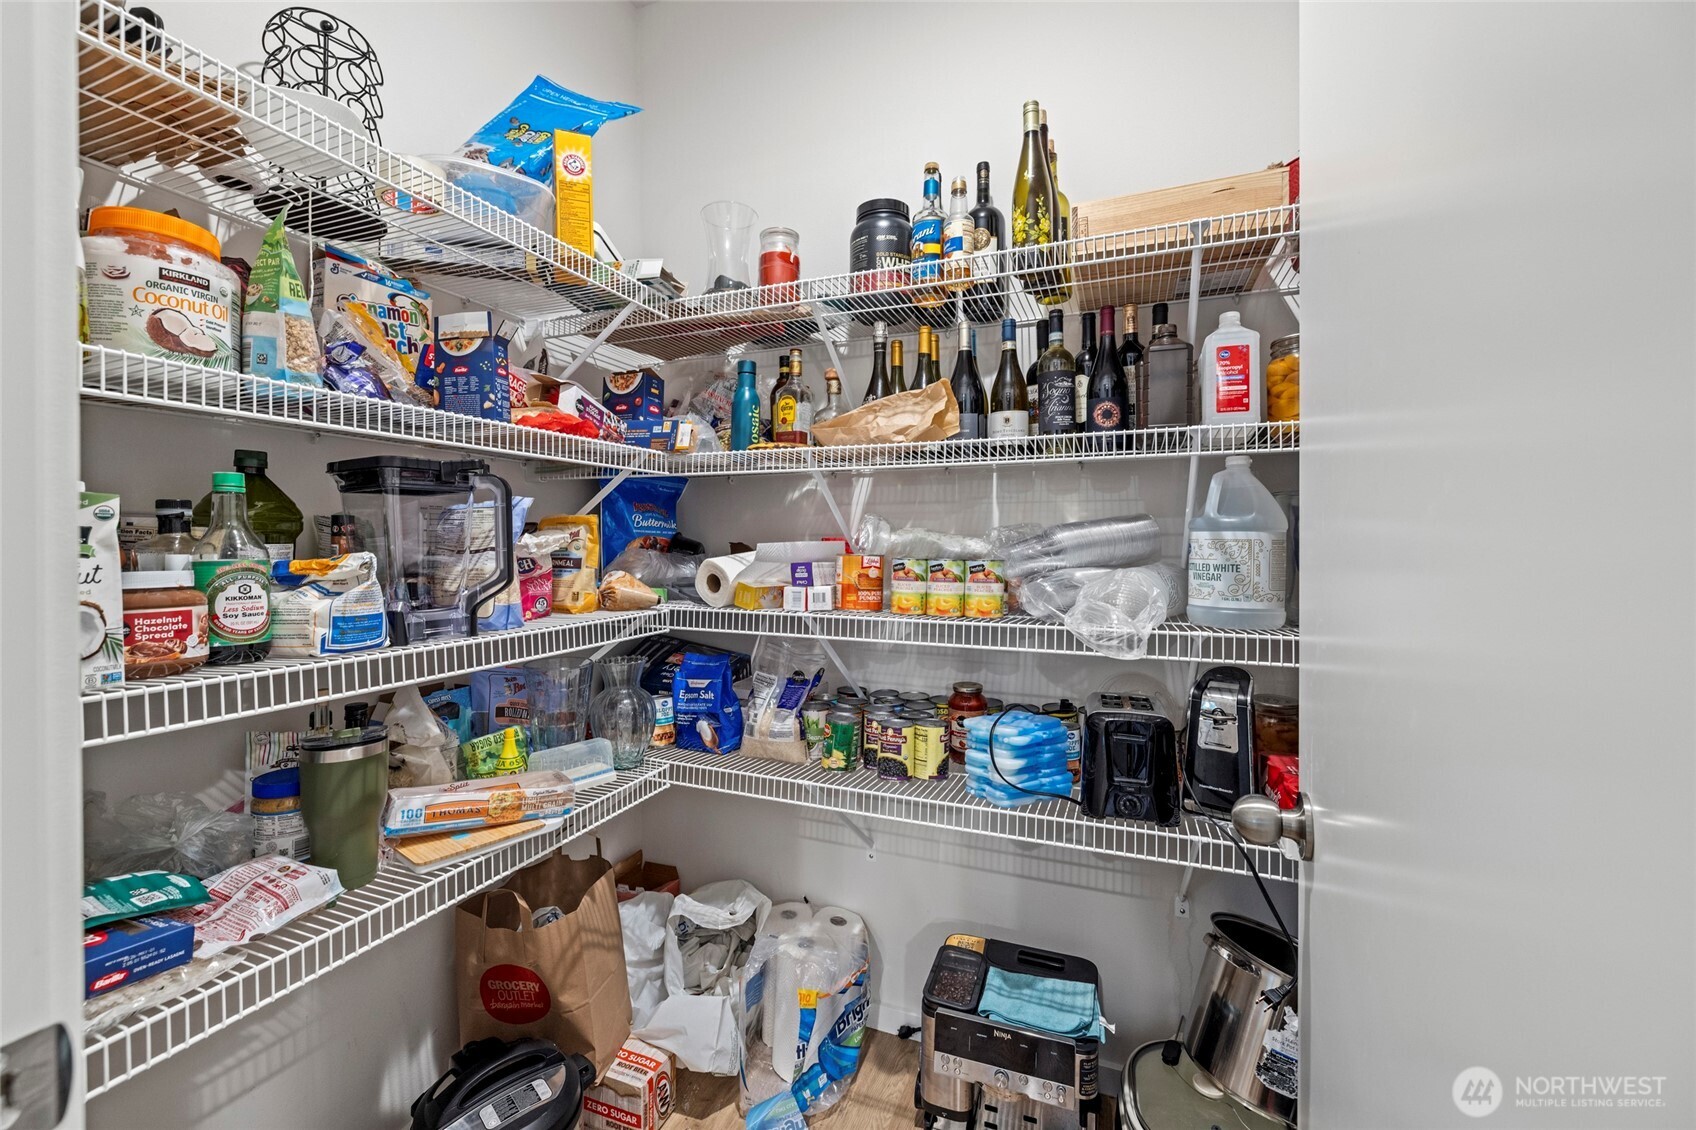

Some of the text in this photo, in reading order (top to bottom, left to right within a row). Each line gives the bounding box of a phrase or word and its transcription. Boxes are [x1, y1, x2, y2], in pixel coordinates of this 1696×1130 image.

[912, 223, 935, 243] rani
[881, 257, 911, 273] WHE
[162, 269, 208, 286] KIRKLAND
[145, 280, 219, 304] ORGANIC VIRGIN
[132, 286, 229, 322] Coconut Oil
[751, 405, 759, 443] osaic
[632, 514, 677, 529] Buttermilk
[1212, 563, 1241, 573] WHITE
[1193, 573, 1222, 582] VINEGAR
[134, 615, 182, 626] Hazelnut
[134, 623, 188, 633] Chocolate
[134, 630, 174, 642] Spread
[679, 690, 714, 702] Epsom Salt
[470, 736, 493, 752] SUGAR
[450, 782, 470, 792] Split
[401, 808, 423, 819] 100
[488, 980, 539, 992] GROCERY
[498, 990, 535, 1001] OUTLET
[490, 999, 519, 1011] bargain
[994, 1029, 1012, 1040] NINJA
[628, 1054, 657, 1069] SUGAR
[617, 1062, 649, 1076] ROOT BEER
[587, 1100, 637, 1125] ZERO SUGAR
